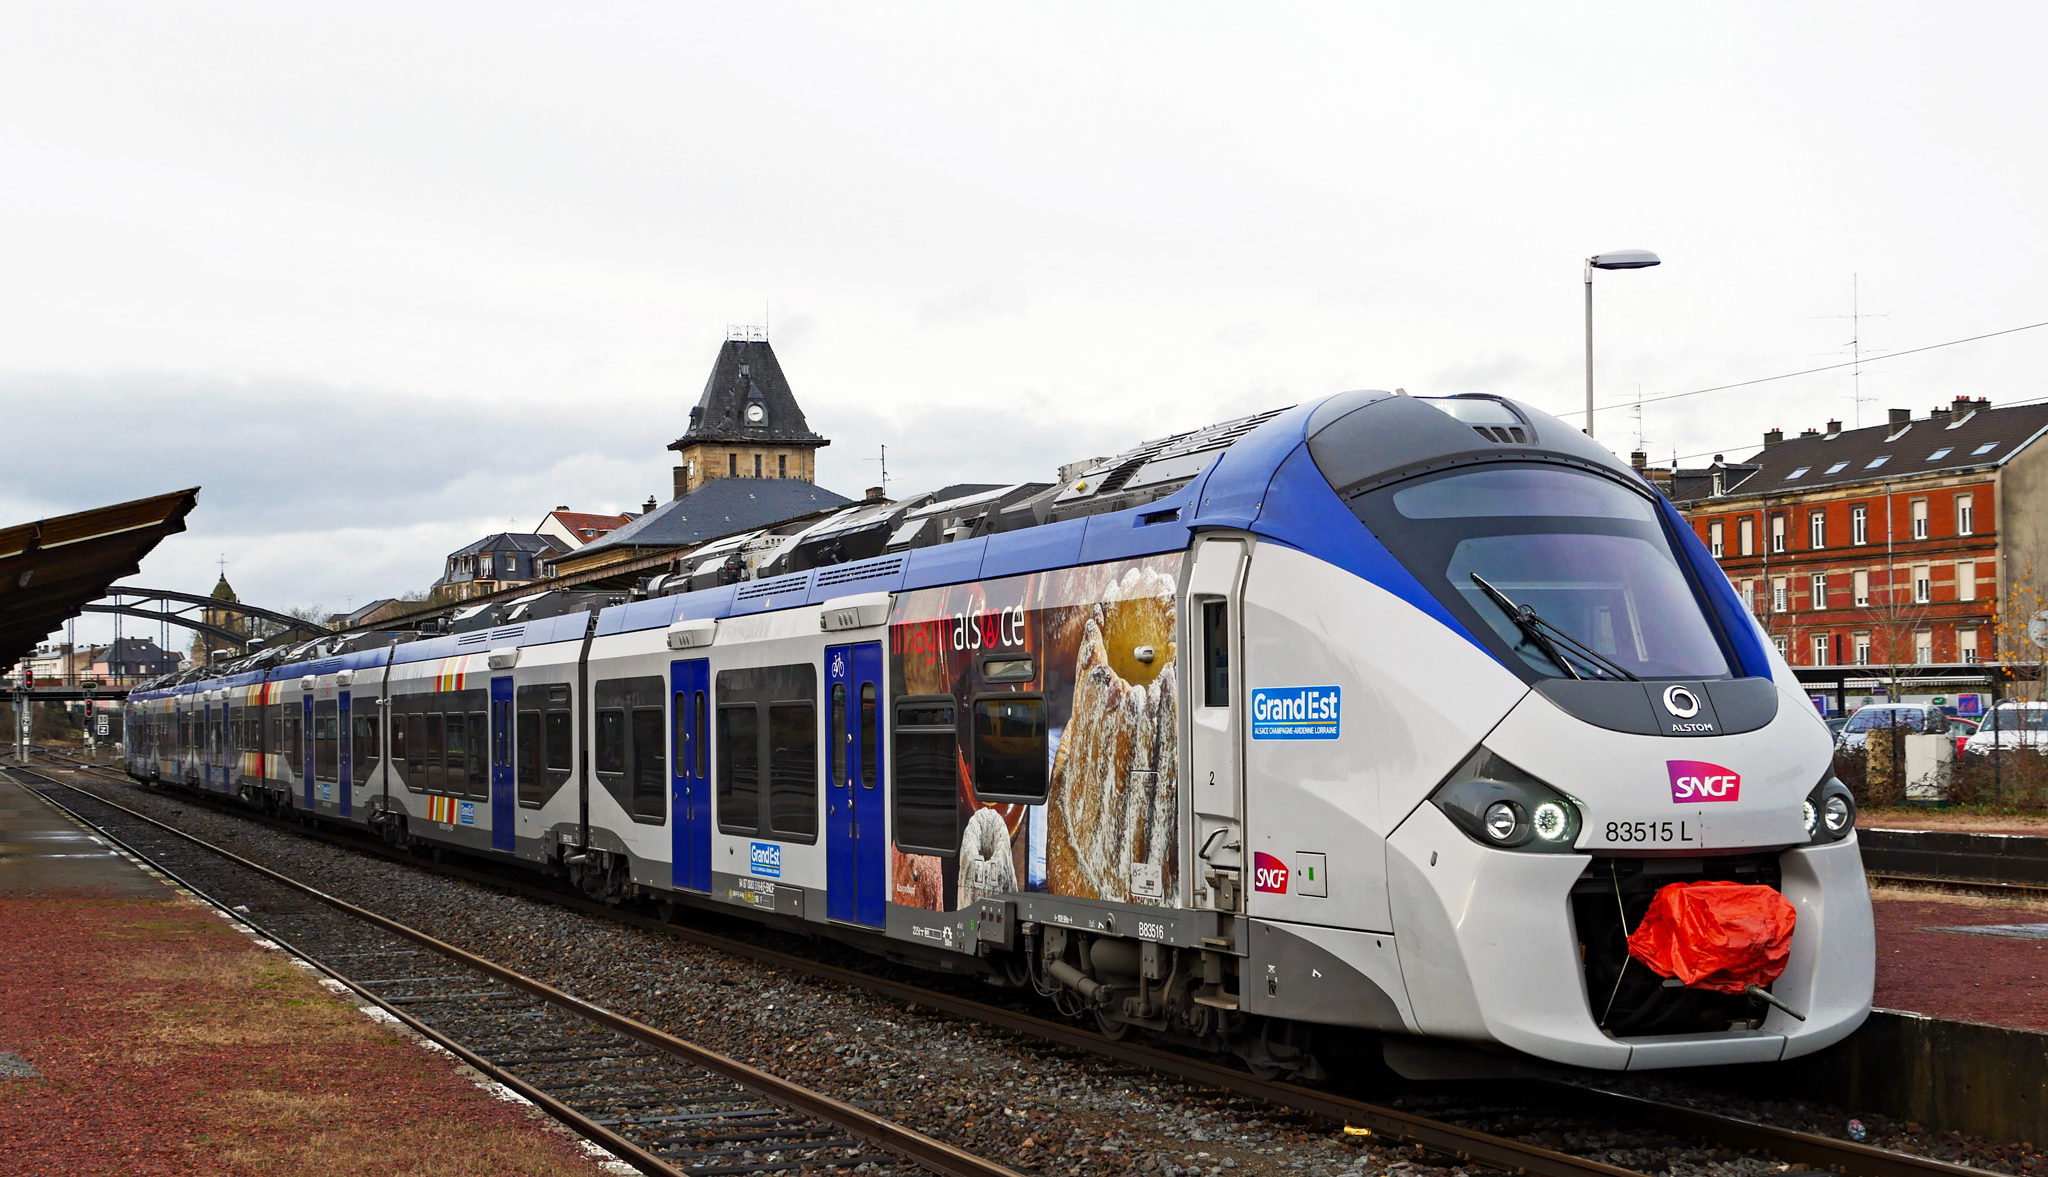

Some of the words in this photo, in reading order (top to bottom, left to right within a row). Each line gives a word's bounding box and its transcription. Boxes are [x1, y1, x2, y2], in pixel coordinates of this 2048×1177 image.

[1254, 691, 1306, 720] Grand
[1308, 691, 1338, 719] Est
[1254, 727, 1269, 735] ALSACE
[1672, 723, 1714, 732] ALSTOM
[1209, 771, 1215, 786] 2
[1675, 776, 1736, 798] SNCF
[1605, 821, 1674, 842] 83515
[1681, 820, 1693, 841] L
[1255, 867, 1287, 889] SNCF
[1138, 921, 1164, 940] B83516
